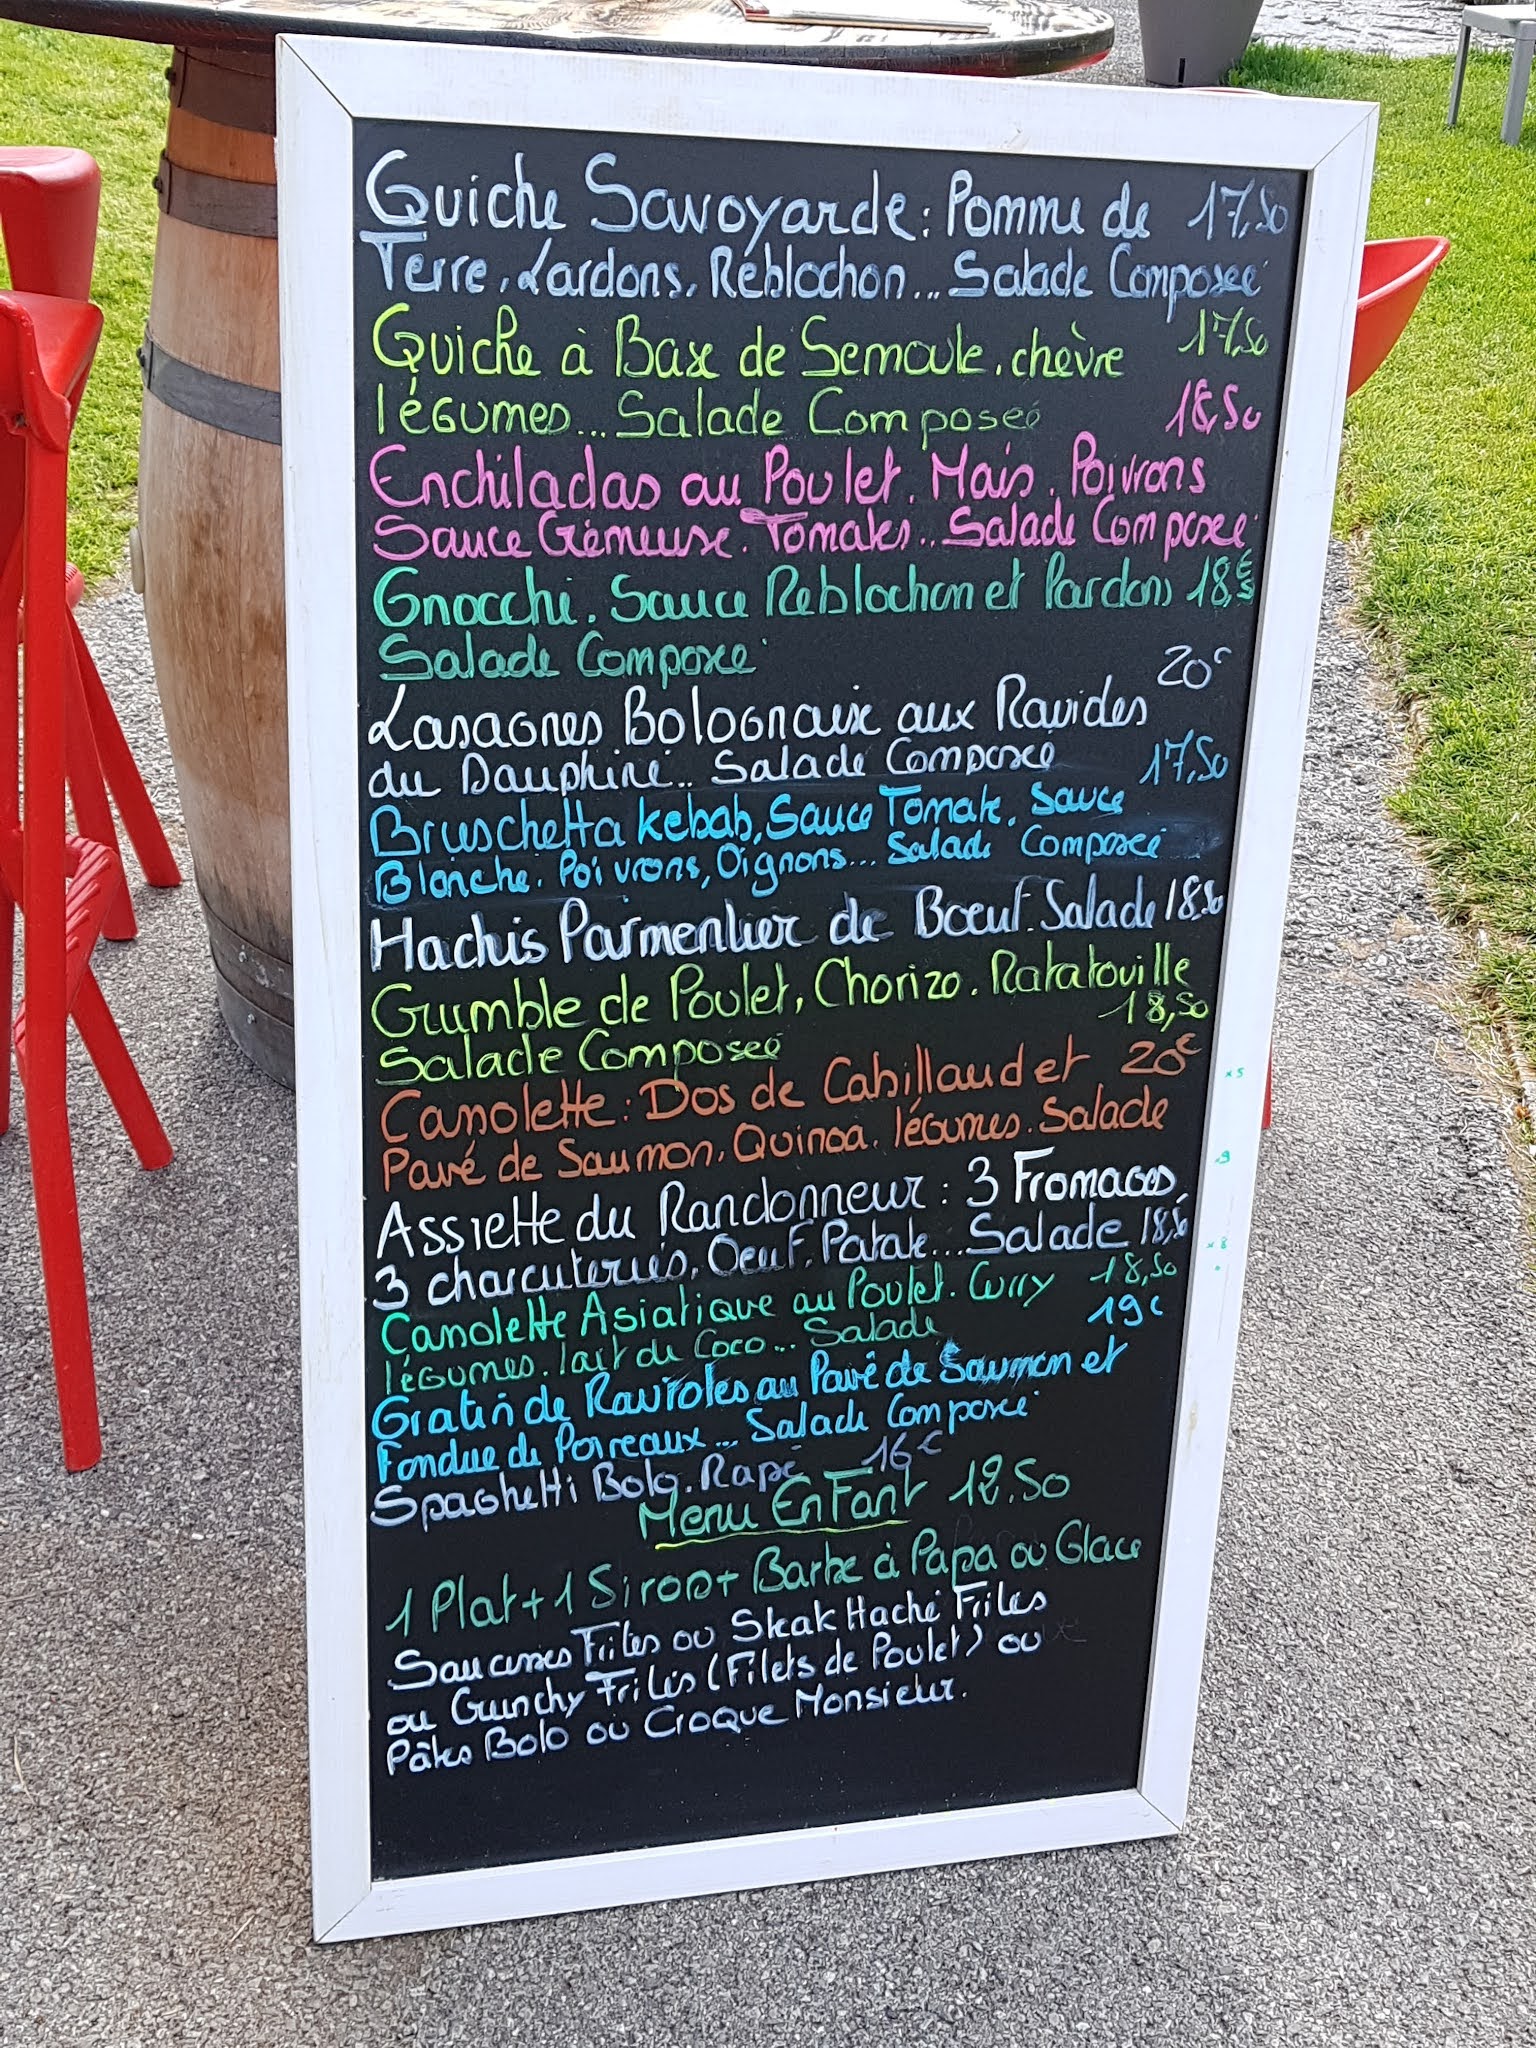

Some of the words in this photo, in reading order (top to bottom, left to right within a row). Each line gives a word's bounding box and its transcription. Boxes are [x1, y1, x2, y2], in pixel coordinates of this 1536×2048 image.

[365, 149, 566, 229] Quiche
[948, 169, 1084, 238] Pomme
[1103, 180, 1150, 238] de
[948, 249, 1092, 298] Salade
[372, 303, 541, 377] Quiche
[561, 328, 593, 376] à
[615, 314, 720, 379] Base
[739, 325, 785, 377] de
[1012, 321, 1124, 378] chèvre
[616, 388, 785, 438] Salade
[369, 444, 661, 510] Enchiladas
[680, 473, 742, 507] au
[1072, 431, 1206, 497] Poivrons
[373, 514, 532, 560] Sauce
[942, 497, 1076, 550] Salade
[610, 573, 749, 623] Sauce
[766, 558, 973, 615] Reblochon
[984, 557, 1026, 611] et
[379, 630, 560, 680] Salade
[897, 698, 975, 732] aux
[368, 762, 441, 799] du
[712, 744, 866, 785] Salade
[369, 798, 625, 857] Bruschetta
[766, 794, 872, 841] Sauce
[1031, 782, 1125, 816] Sauce
[887, 829, 992, 865] Salade
[370, 913, 549, 973] Hachis
[559, 896, 817, 963] Parmentier
[829, 892, 894, 946] de
[1040, 873, 1156, 931] Salade
[600, 974, 650, 1025] de
[377, 1033, 564, 1085] Salade
[640, 1078, 735, 1121] Dos
[751, 1067, 804, 1112] de
[824, 1043, 1024, 1106] Cabillaud
[1034, 1034, 1091, 1083] et
[498, 1140, 542, 1183] de
[1038, 1083, 1168, 1132] Salade
[376, 1190, 565, 1259] Assiette
[576, 1193, 635, 1242] du
[967, 1156, 999, 1208] 3
[373, 1264, 409, 1311] 3
[966, 1202, 1129, 1256] Salade
[793, 1288, 836, 1315] au
[969, 1260, 1055, 1307] Curry
[559, 1337, 632, 1376] lait
[635, 1335, 677, 1368] de
[803, 1311, 941, 1347] Salade
[371, 1389, 516, 1441] Gratin
[524, 1386, 571, 1425] de
[757, 1373, 798, 1401] au
[885, 1350, 932, 1389] de
[939, 1338, 1072, 1388] Saumon
[1081, 1334, 1130, 1376] et
[376, 1438, 500, 1485] Fondue
[508, 1432, 542, 1470] de
[746, 1400, 869, 1443] Salade
[639, 1491, 760, 1540] Menu
[431, 1572, 517, 1632] Plat
[588, 1564, 712, 1609] Sirop
[874, 1541, 900, 1579] à
[911, 1527, 998, 1588] Papa
[1010, 1541, 1047, 1568] ou
[1055, 1519, 1142, 1563] Glace
[672, 1626, 716, 1652] ou
[846, 1589, 940, 1631] Haché
[386, 1710, 438, 1736] ou
[824, 1638, 859, 1675] de
[998, 1628, 1043, 1654] ou
[386, 1733, 473, 1775] Pâtes
[485, 1720, 570, 1762] Bolo
[586, 1713, 630, 1746] ou
